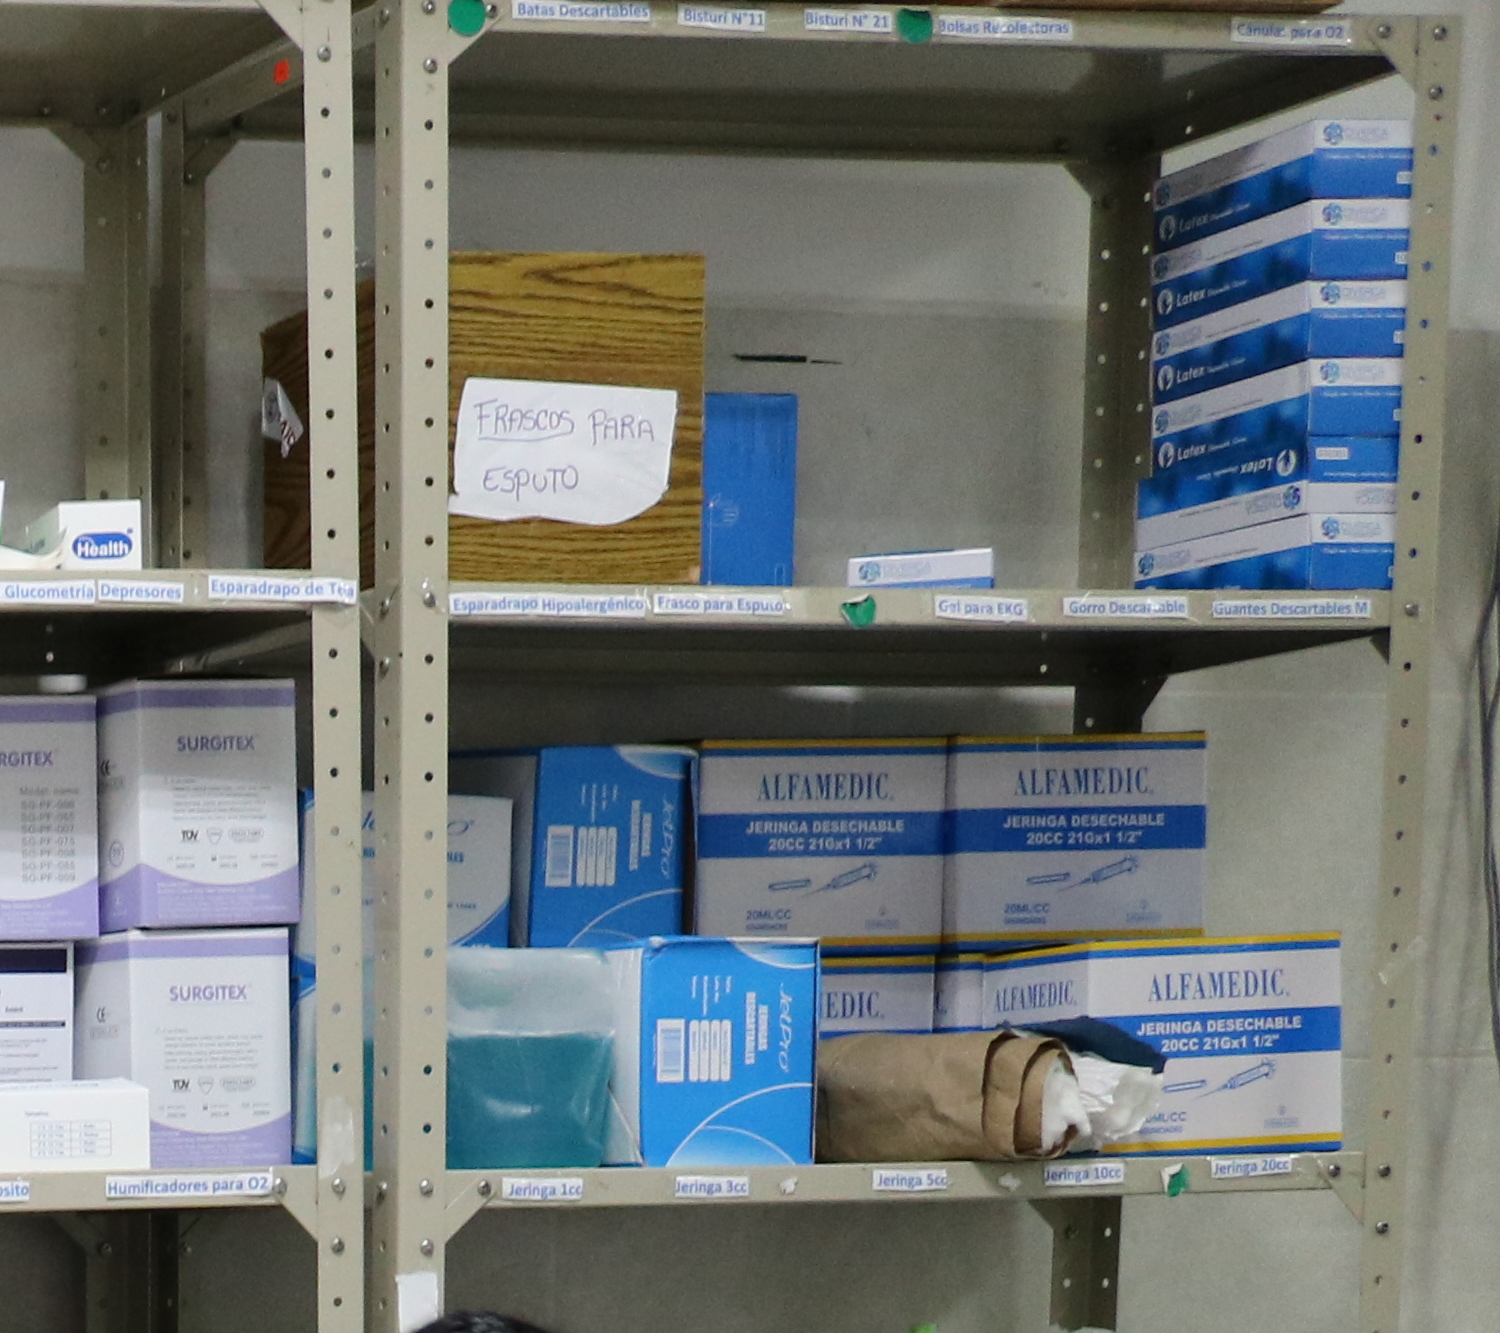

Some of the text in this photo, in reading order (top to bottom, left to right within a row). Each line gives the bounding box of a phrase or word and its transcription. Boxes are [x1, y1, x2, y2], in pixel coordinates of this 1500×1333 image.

[517, 3, 649, 19] Batas Descartables
[805, 12, 888, 29] Bisturi 21
[474, 399, 655, 446] FRASCOS PARA
[483, 466, 579, 501] ESPUTO
[77, 538, 130, 557] Health
[101, 583, 181, 600] Depresores
[211, 580, 324, 598] Esparadrapo de
[453, 596, 538, 615] Esparadrapo
[658, 596, 699, 610] Frasco
[703, 600, 733, 613] para
[965, 603, 993, 617] para
[998, 605, 1022, 616] EKG
[1070, 601, 1105, 614] Gorro
[1214, 602, 1368, 616] Guantes Descartables M
[177, 735, 256, 753] SURGITEX
[758, 773, 889, 801] ALFAMEDIC
[1013, 767, 1149, 797] ALFAMEDIC
[746, 819, 904, 834] JERINGA DESECHABLE
[1003, 813, 1165, 829] JERINGA DESECHABLE
[768, 837, 804, 851] 20CC
[1026, 831, 1063, 845] 20CC
[169, 984, 247, 1002] SURGITEX
[1149, 967, 1284, 1003] ALFAMEDIC
[992, 980, 1075, 1013] ALFAMEDIC
[1136, 1015, 1302, 1036] JERINGA DESECHABLE
[1161, 1037, 1198, 1052] 20CC
[1045, 1166, 1121, 1184] Jeringa 10cc
[1213, 1159, 1289, 1177] Jeringa 20cc
[108, 1179, 243, 1195] Humificadores para
[676, 1180, 747, 1197] Jeringa 3cc
[878, 1173, 947, 1190] Jeringa 5cc
[510, 1182, 582, 1200] Jeringa 1cc
